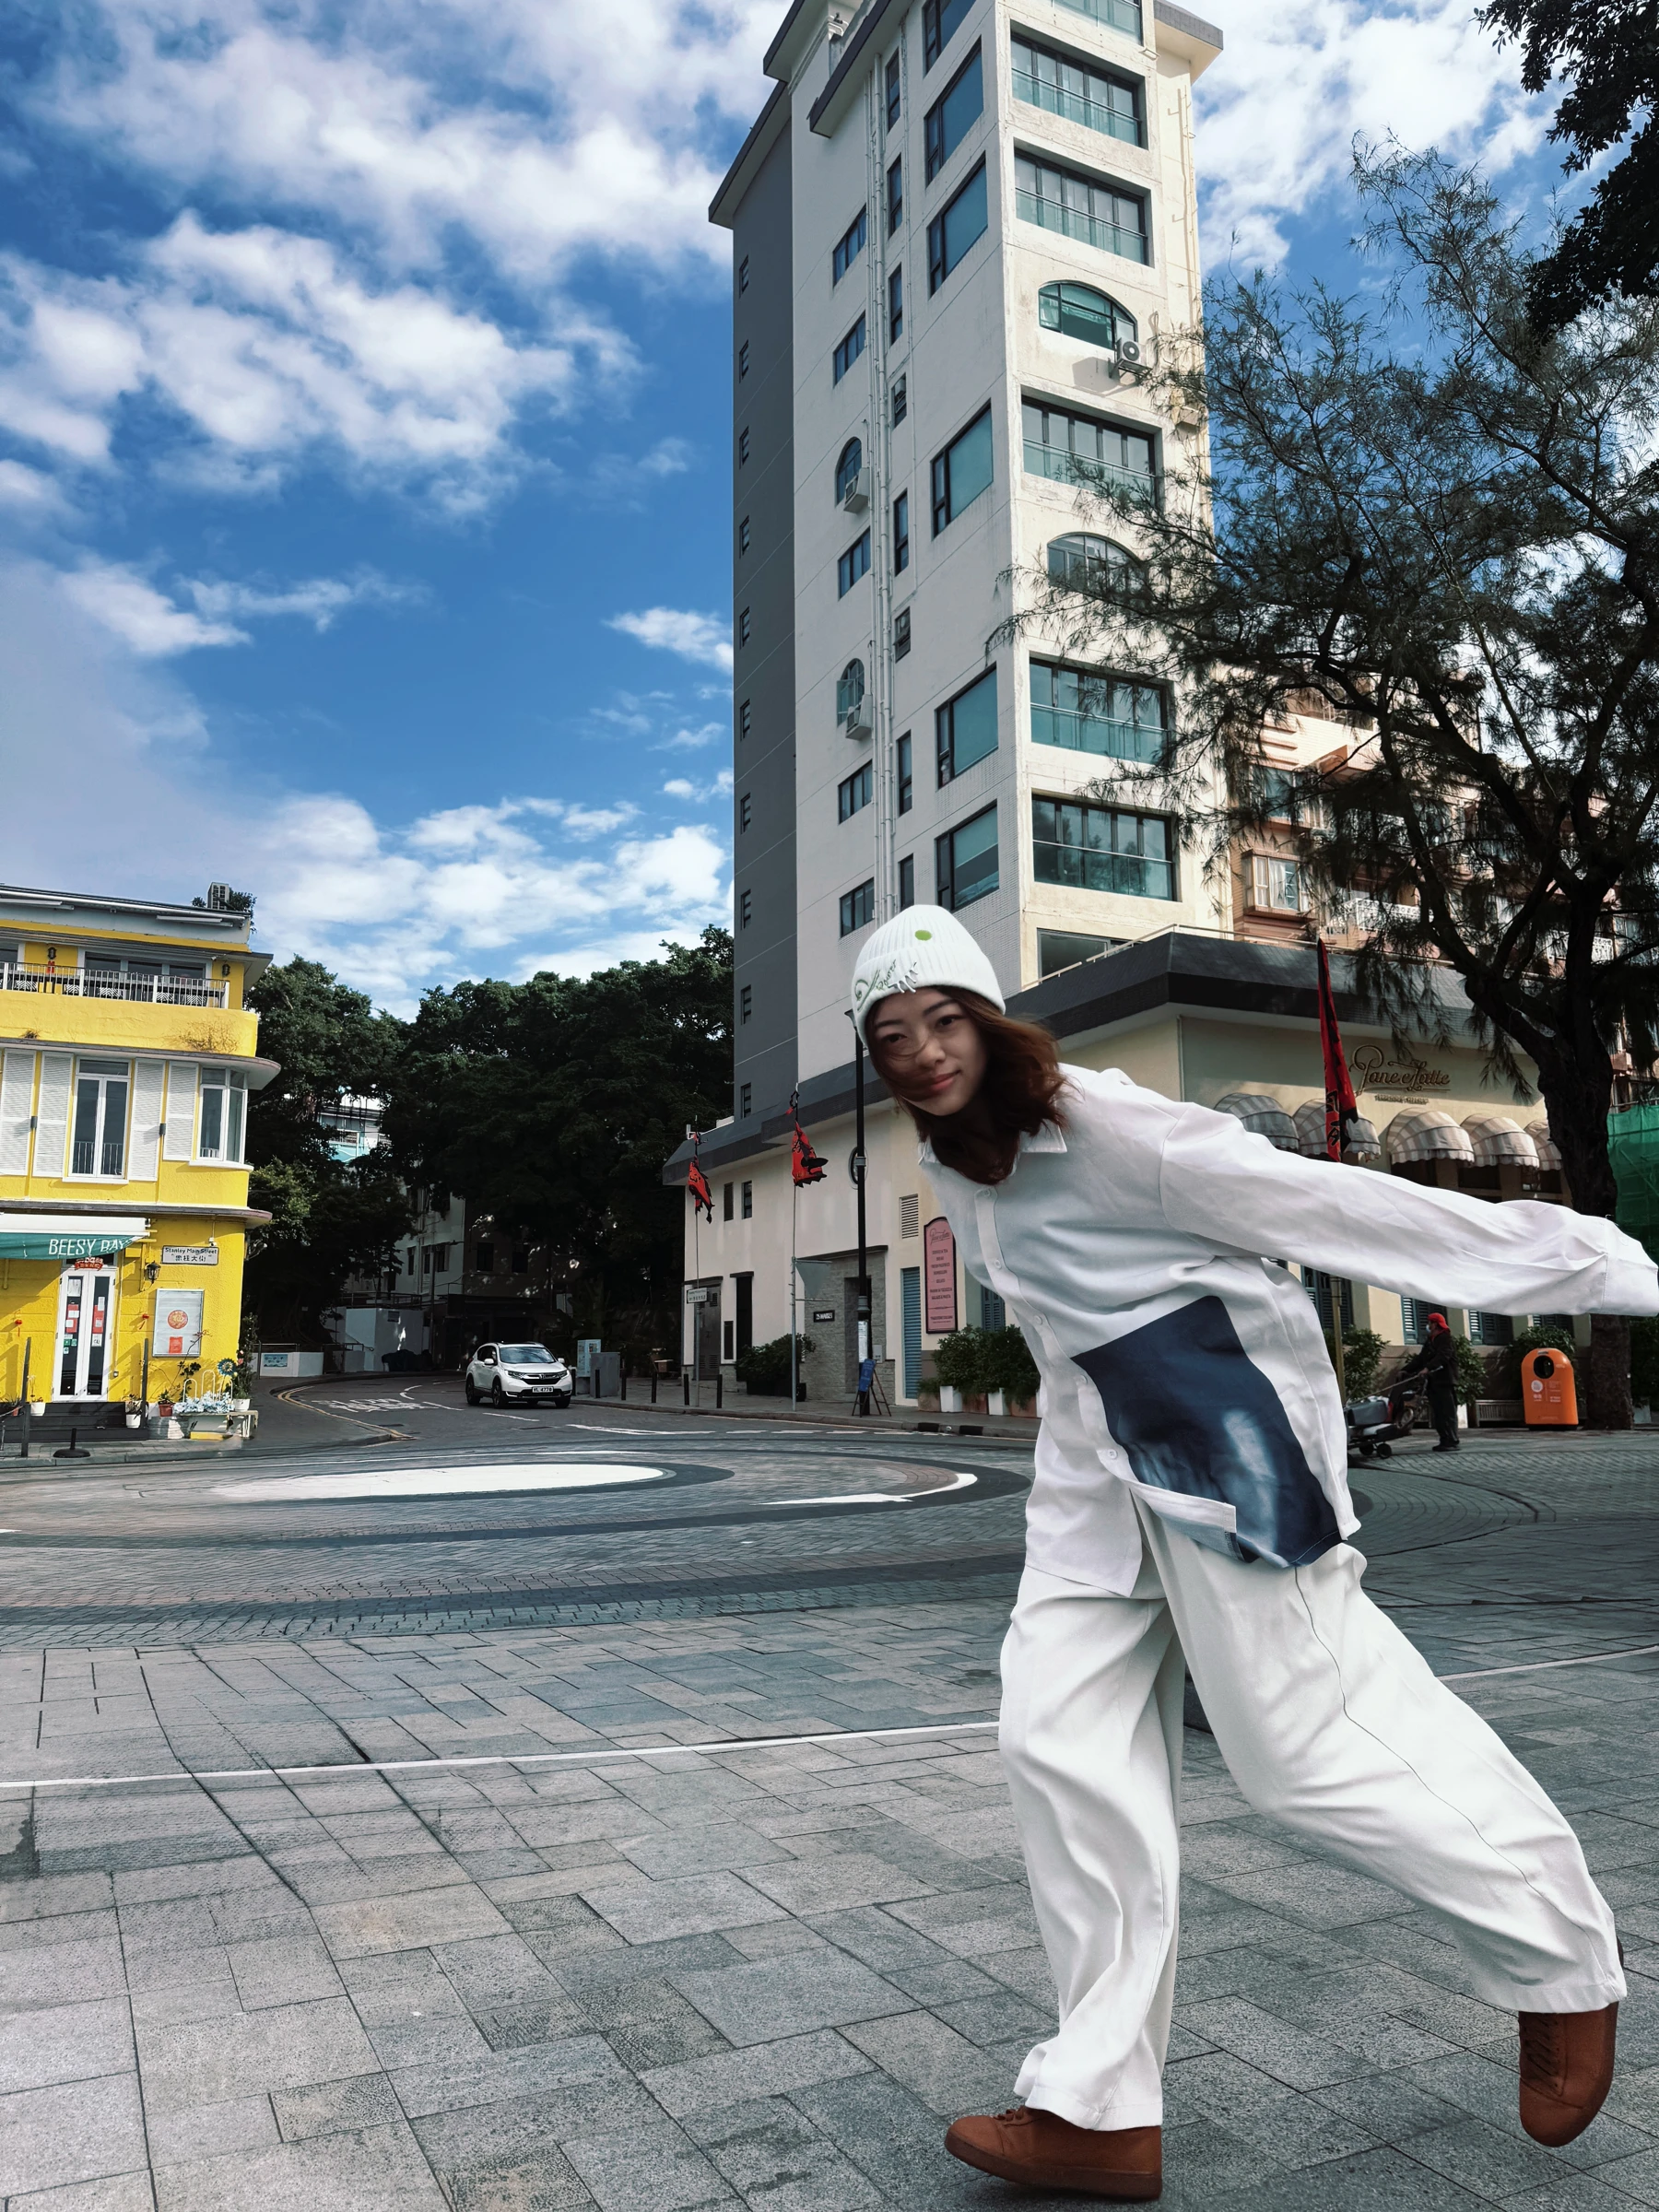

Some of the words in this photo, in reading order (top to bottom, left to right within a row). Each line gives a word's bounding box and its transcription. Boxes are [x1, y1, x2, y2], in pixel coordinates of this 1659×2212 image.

[1348, 1045, 1400, 1097] Pane
[1388, 1058, 1451, 1091] Latte
[48, 1238, 97, 1257] BEESY
